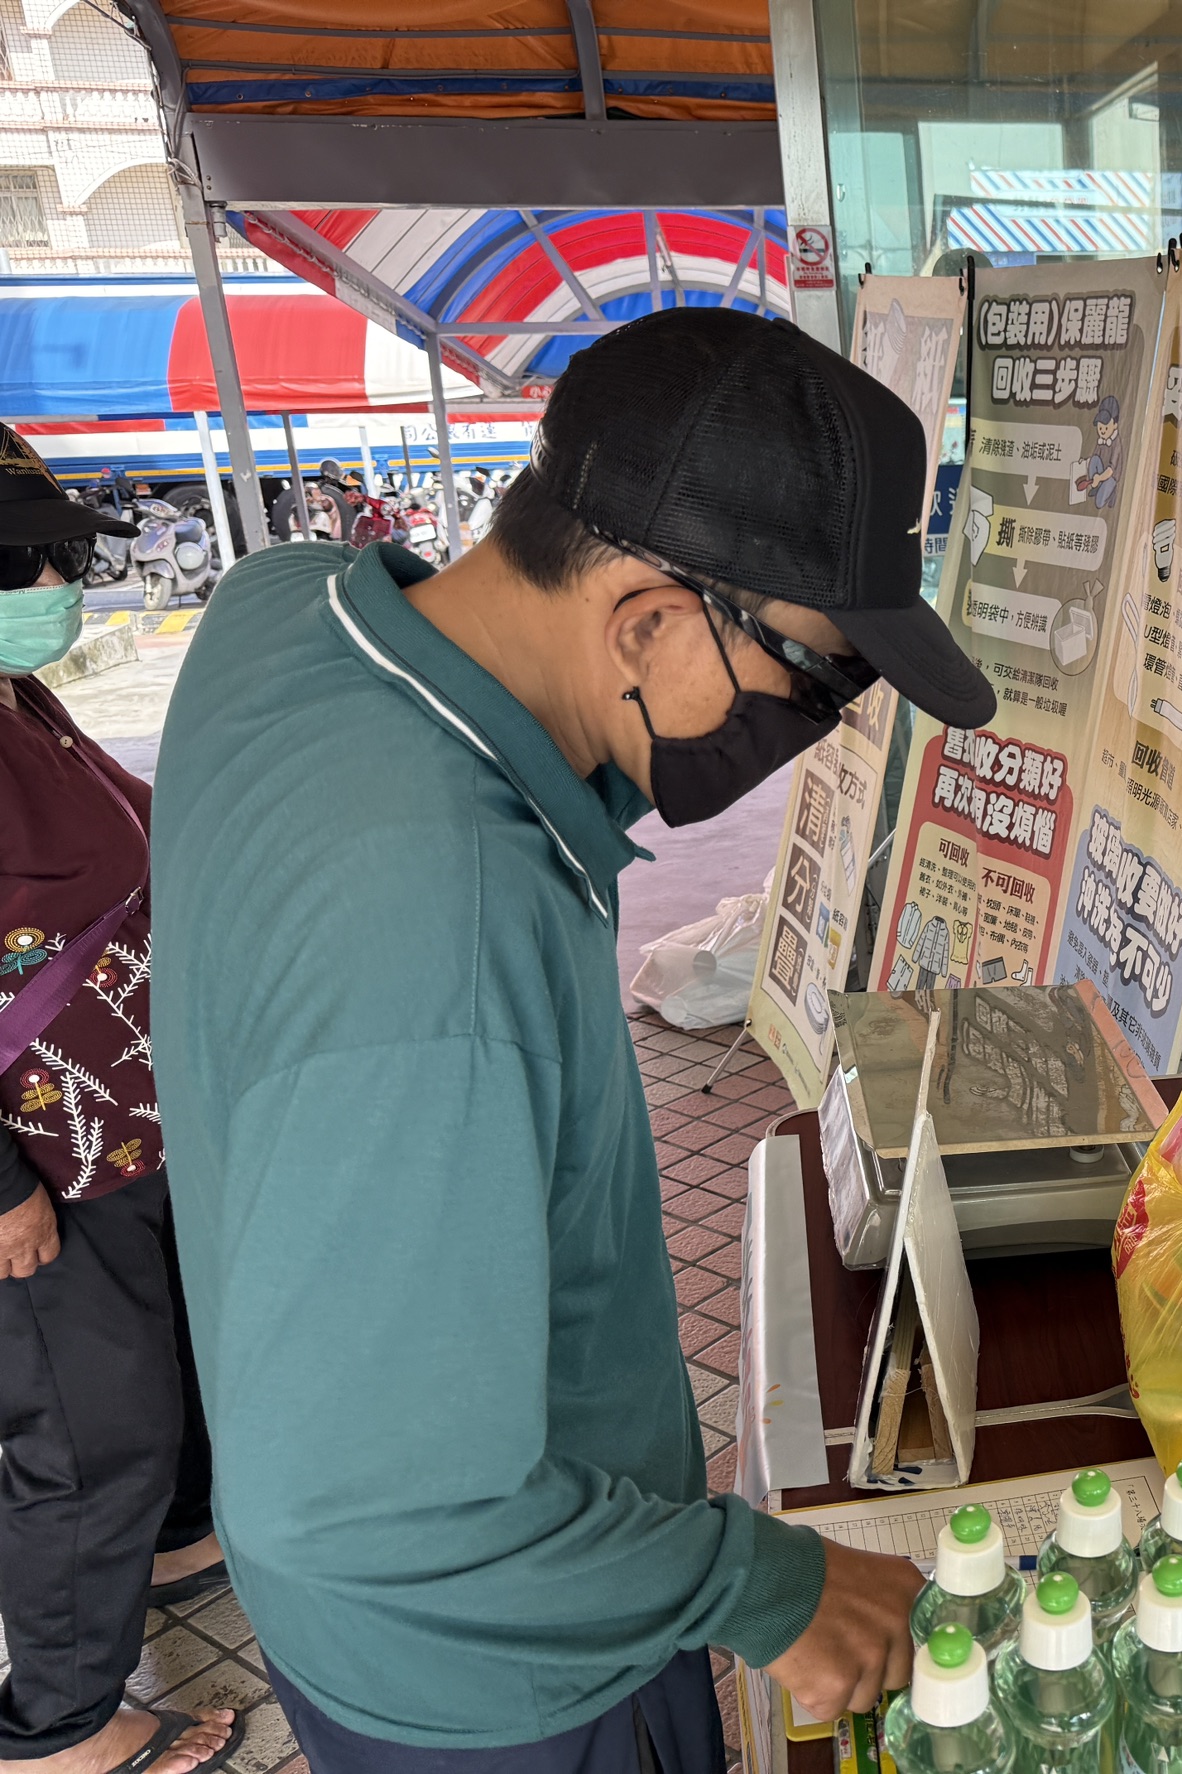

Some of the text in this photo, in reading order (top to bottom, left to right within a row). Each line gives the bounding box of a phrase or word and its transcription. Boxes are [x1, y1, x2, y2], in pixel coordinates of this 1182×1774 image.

[992, 357, 1102, 403] 回收三步驟
[996, 517, 1016, 548] 撕
[991, 684, 1068, 717] ，就算是一般垃圾喔
[800, 776, 825, 842] 清
[938, 838, 970, 867] 可回收
[788, 855, 810, 913] 分
[981, 867, 1036, 904] 不可回收
